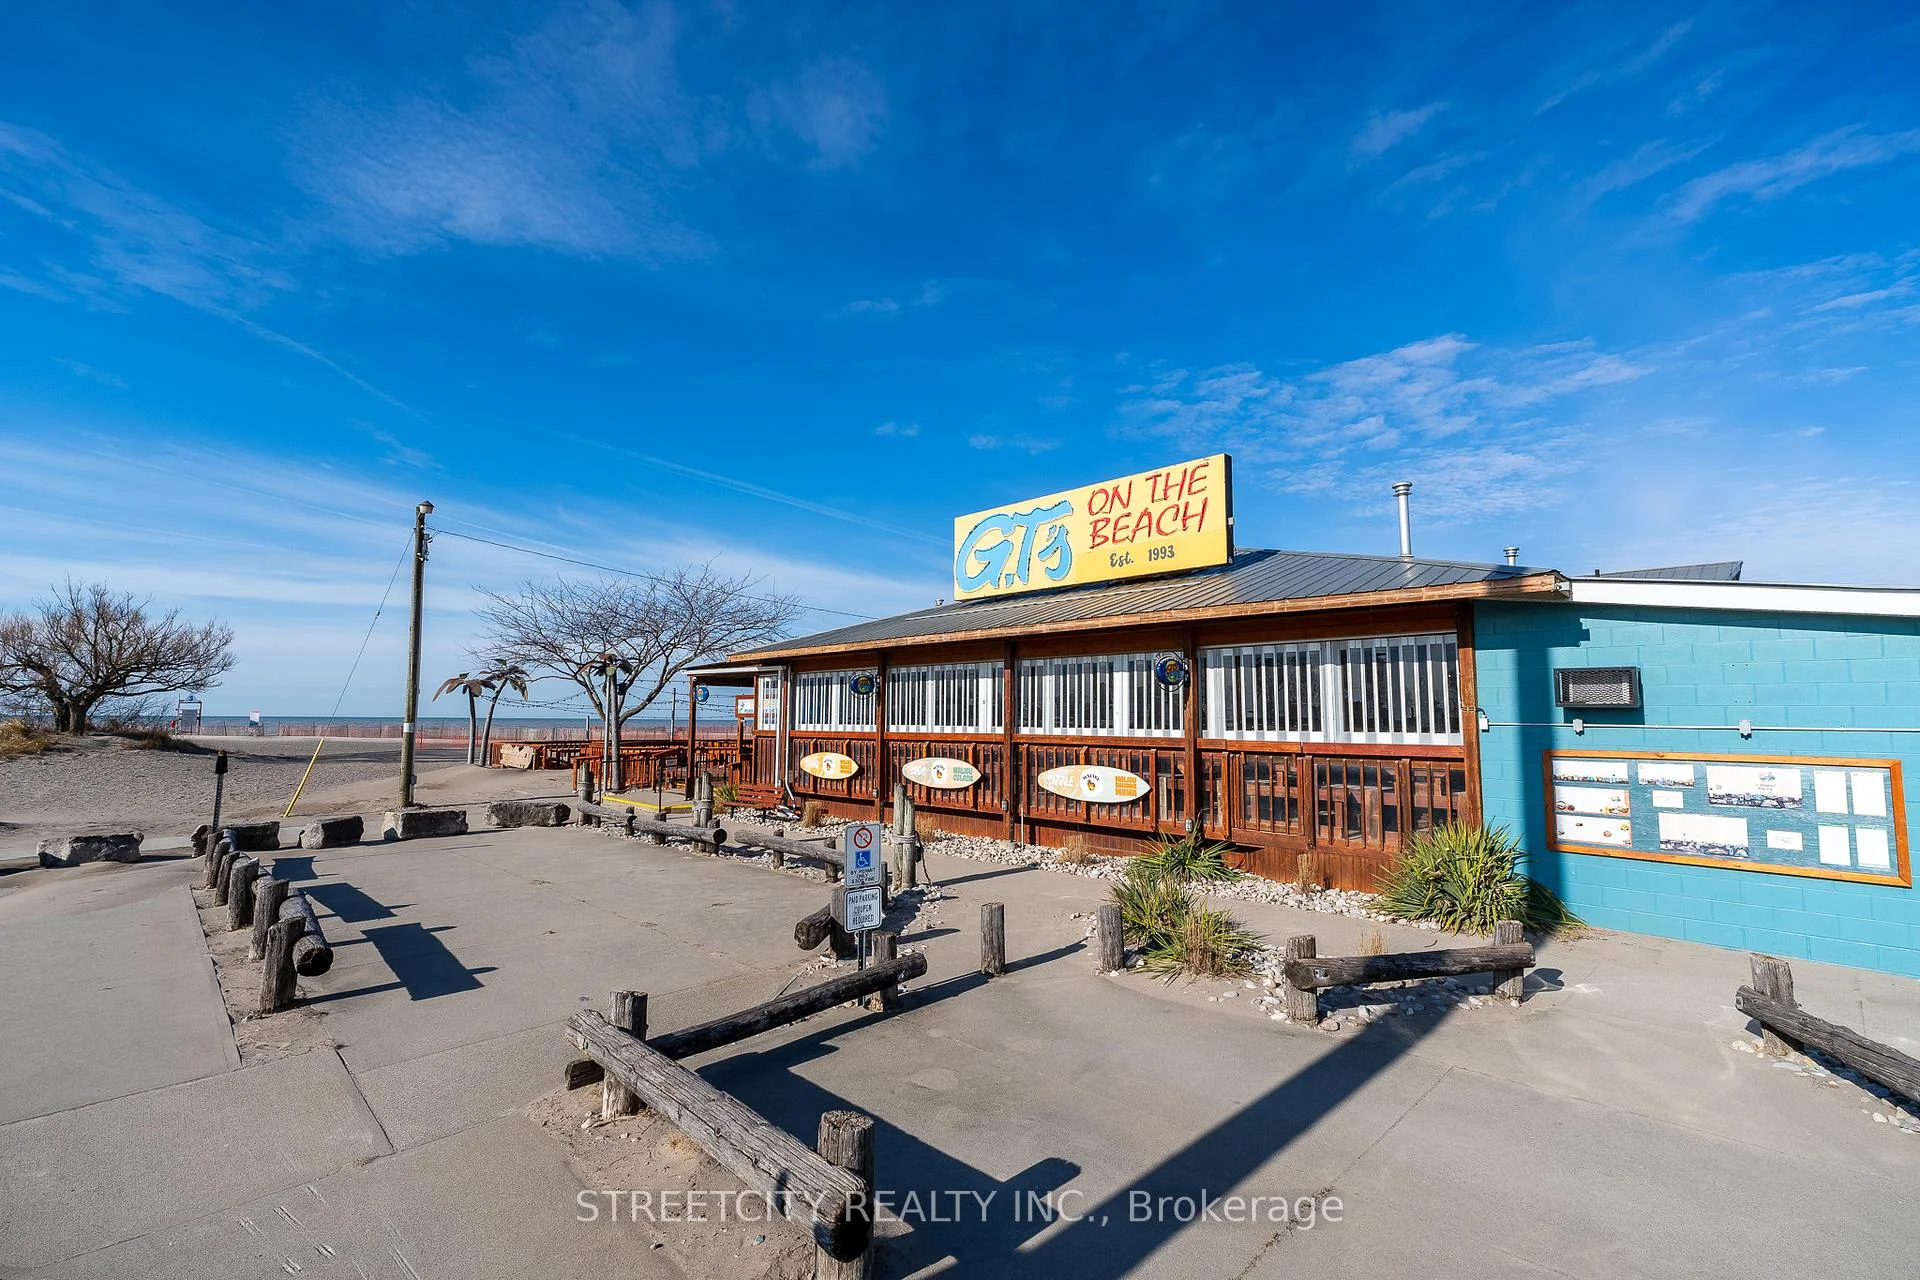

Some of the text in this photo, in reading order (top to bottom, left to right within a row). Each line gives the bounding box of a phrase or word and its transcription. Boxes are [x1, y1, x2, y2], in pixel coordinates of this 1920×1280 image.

[1087, 462, 1209, 516] ON THE
[1089, 496, 1208, 550] BEACH
[1109, 545, 1175, 569] Est. 1993
[848, 892, 878, 904] PAID PARKING
[854, 904, 872, 914] COUPON
[852, 914, 874, 924] REQUIRED
